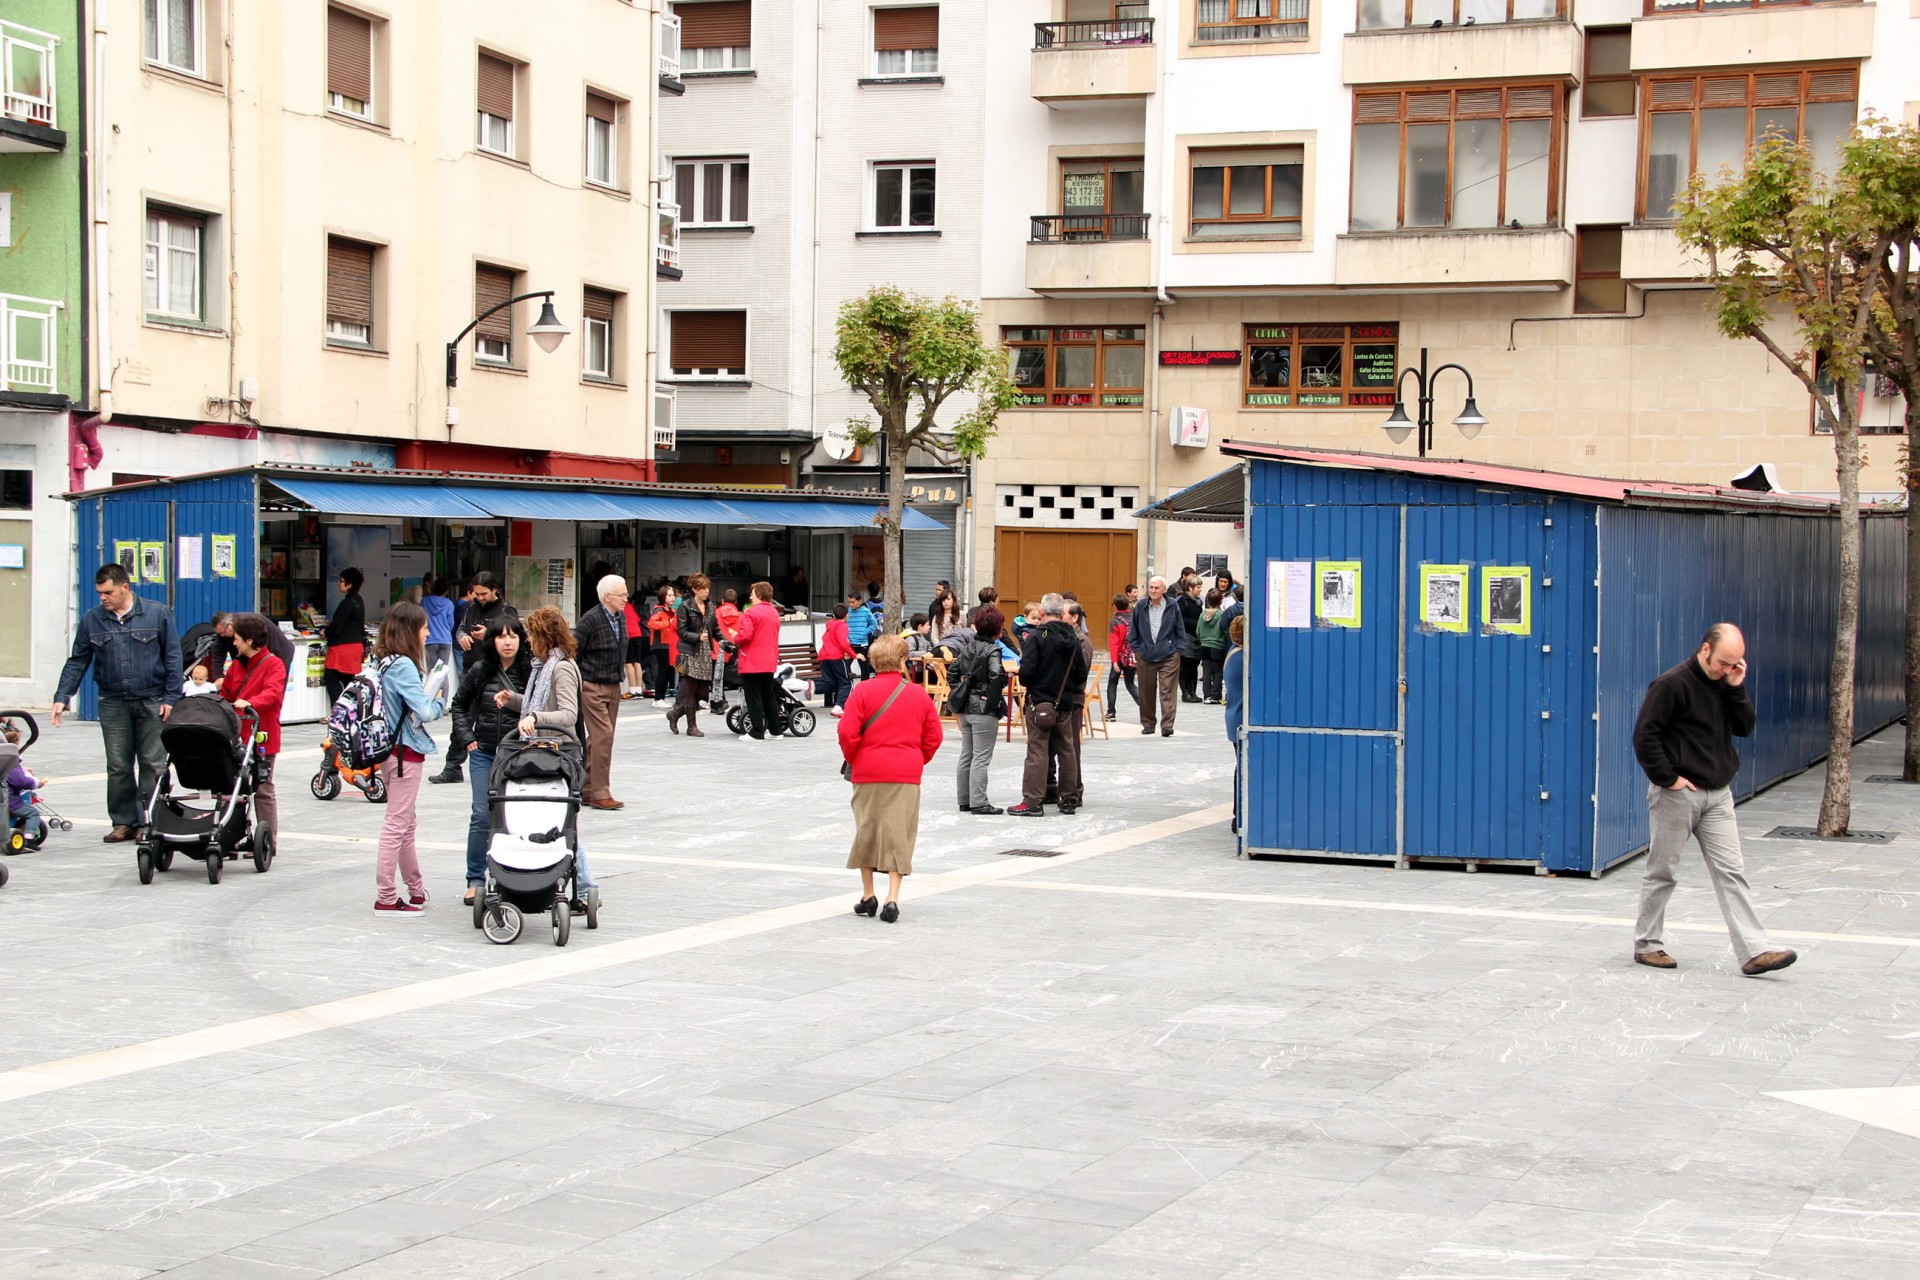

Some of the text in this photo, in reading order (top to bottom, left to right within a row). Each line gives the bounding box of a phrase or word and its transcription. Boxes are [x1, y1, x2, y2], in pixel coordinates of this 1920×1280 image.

[1064, 187, 1104, 196] 943 172 50
[1064, 196, 1077, 205] 943
[1079, 196, 1091, 205] 171
[1162, 351, 1192, 359] OPTICA
[1206, 351, 1236, 359] CASADO
[828, 430, 845, 439] Telev
[911, 485, 956, 502] Pub
